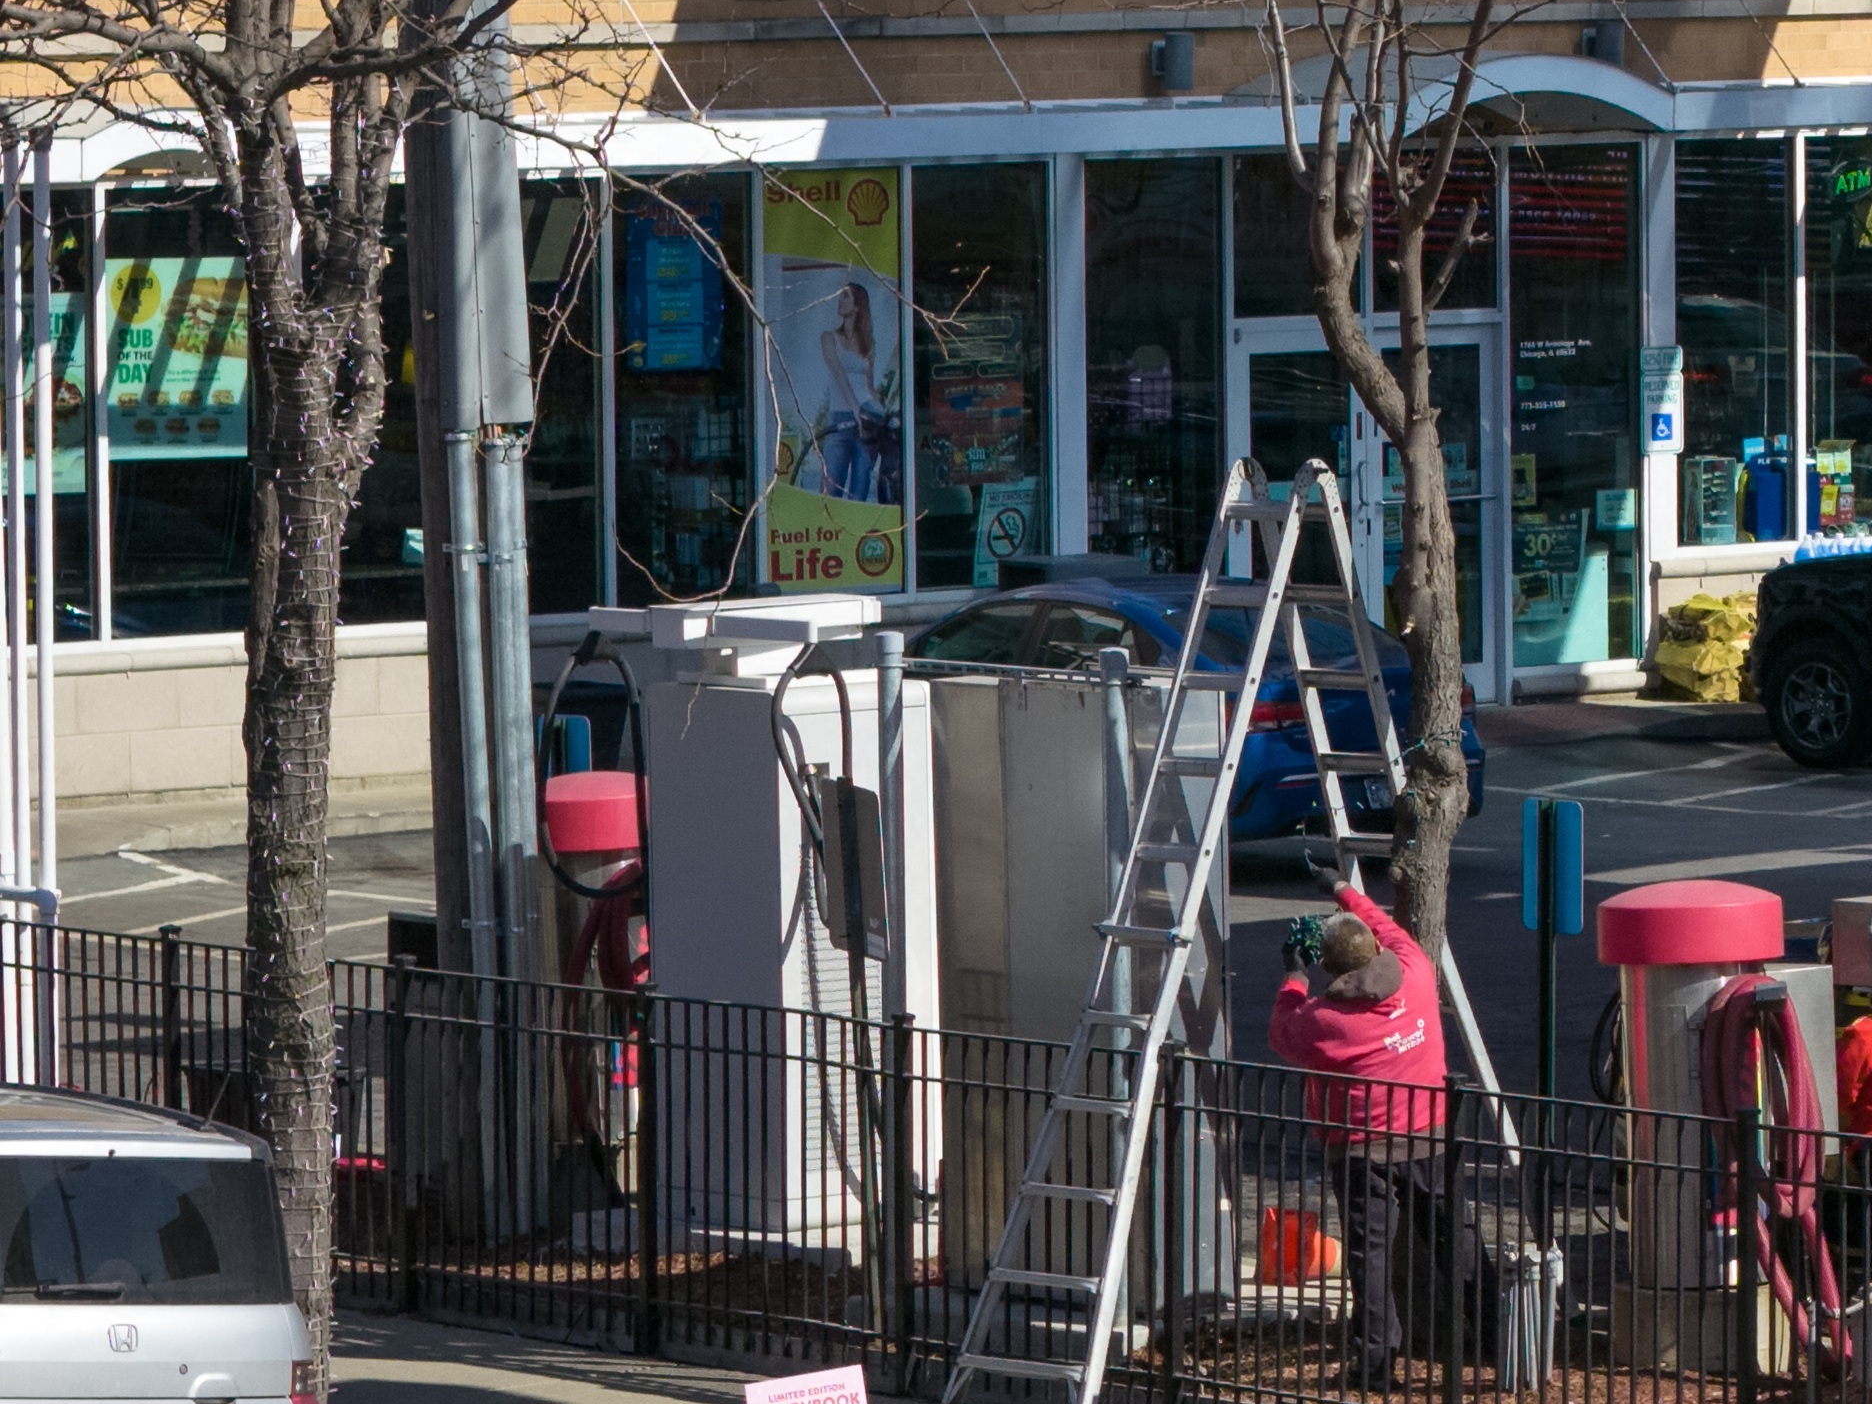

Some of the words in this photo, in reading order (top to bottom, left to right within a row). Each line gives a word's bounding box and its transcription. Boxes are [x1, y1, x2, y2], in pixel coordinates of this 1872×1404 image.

[766, 180, 840, 203] Shell
[1835, 168, 1871, 195] ATM
[118, 328, 152, 349] SUB
[117, 351, 131, 360] OF
[134, 351, 152, 360] THE
[118, 364, 152, 384] DAY
[770, 528, 810, 544] Fuel
[816, 527, 842, 542] for
[771, 548, 843, 582] Life
[768, 1389, 806, 1403] LIMITED
[808, 1382, 845, 1397] EDITION
